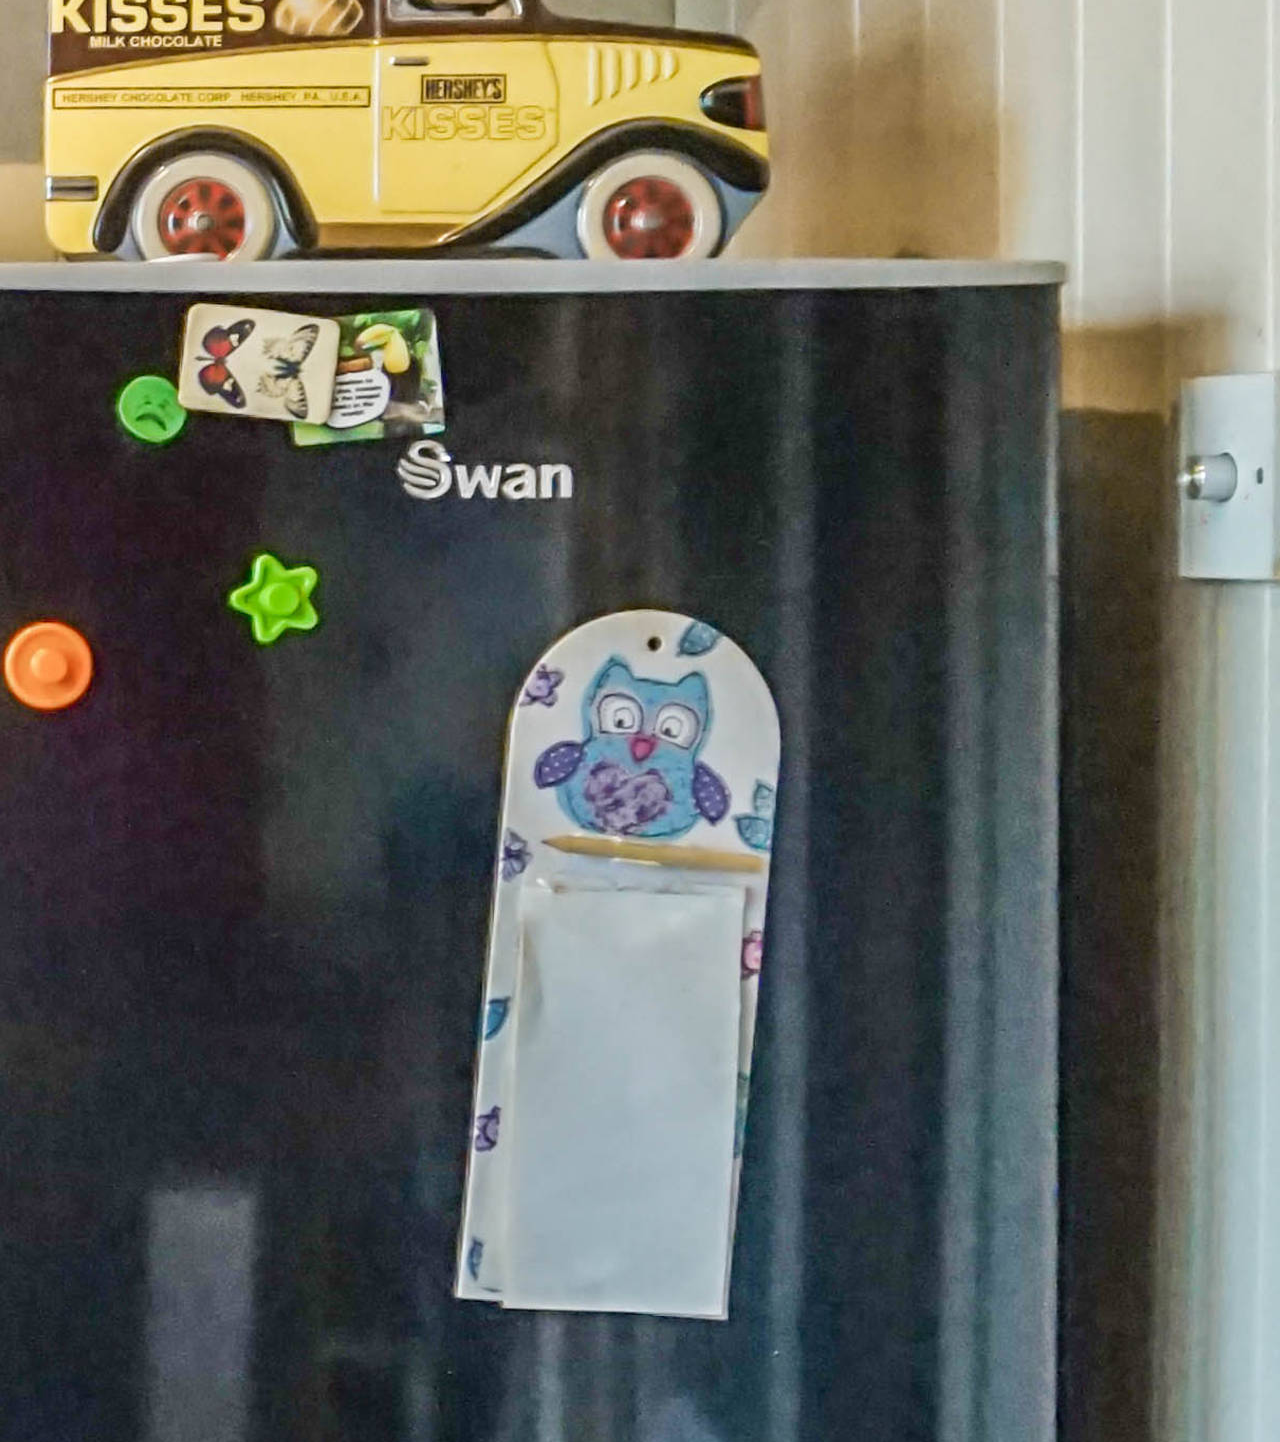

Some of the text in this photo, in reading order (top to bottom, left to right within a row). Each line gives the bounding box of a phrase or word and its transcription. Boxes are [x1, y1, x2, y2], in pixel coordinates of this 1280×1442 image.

[90, 34, 222, 48] MILK CHOCOLATE
[62, 92, 117, 103] HERSHEY
[120, 92, 192, 103] CHOCOLATE
[425, 77, 503, 100] HERSHEY'S
[382, 105, 547, 142] KISSES
[397, 439, 574, 500] Swan
